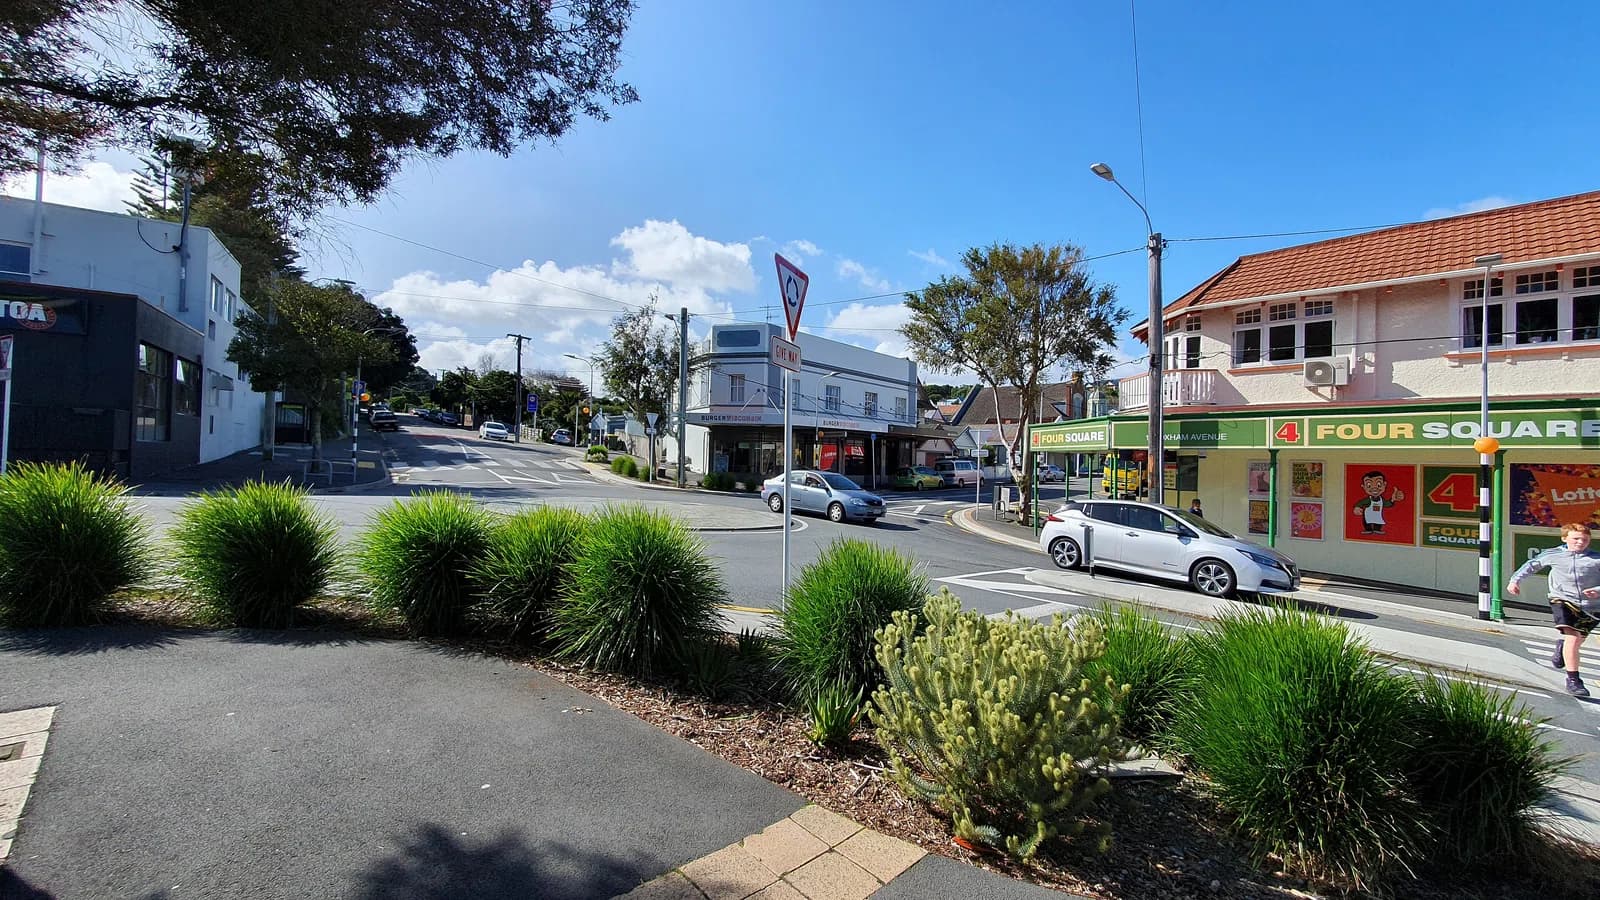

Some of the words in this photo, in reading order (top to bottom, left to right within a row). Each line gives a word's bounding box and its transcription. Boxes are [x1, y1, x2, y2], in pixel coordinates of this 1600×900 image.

[776, 345, 787, 361] GIVE
[788, 350, 798, 363] WAY
[1032, 432, 1039, 446] 4
[1041, 434, 1064, 444] FOUR
[1065, 431, 1105, 443] SQUARE
[1163, 433, 1188, 441] XHAM
[1190, 432, 1228, 441] AVENUE
[1274, 421, 1301, 443] 4
[1316, 423, 1414, 440] FOUR
[1428, 473, 1480, 512] 4
